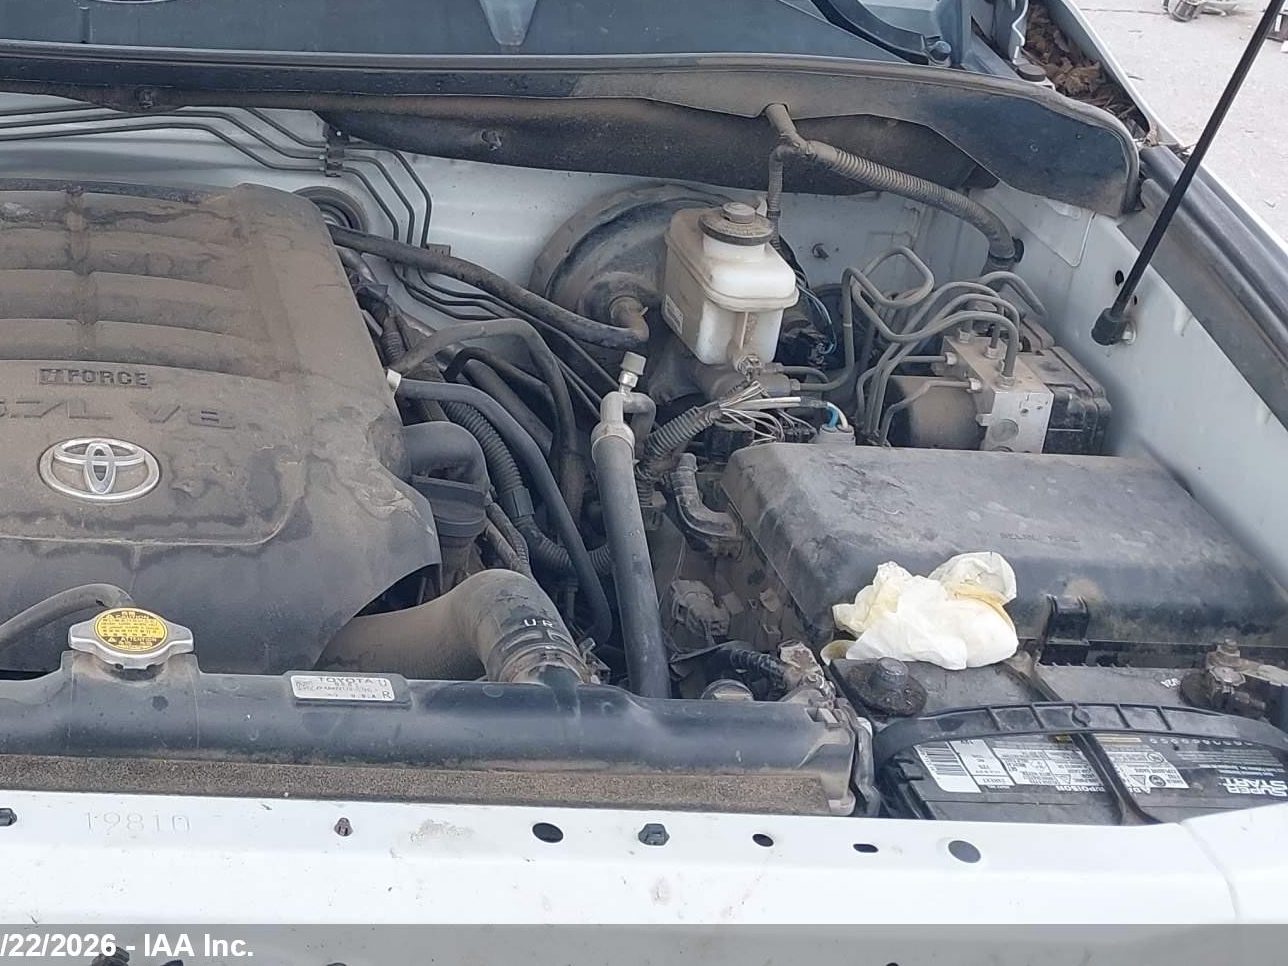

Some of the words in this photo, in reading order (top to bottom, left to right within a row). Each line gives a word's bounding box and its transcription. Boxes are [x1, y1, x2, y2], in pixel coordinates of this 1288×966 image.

[130, 400, 236, 430] V8
[382, 690, 391, 699] R
[1222, 778, 1288, 790] START
[1226, 786, 1288, 797] SUPER
